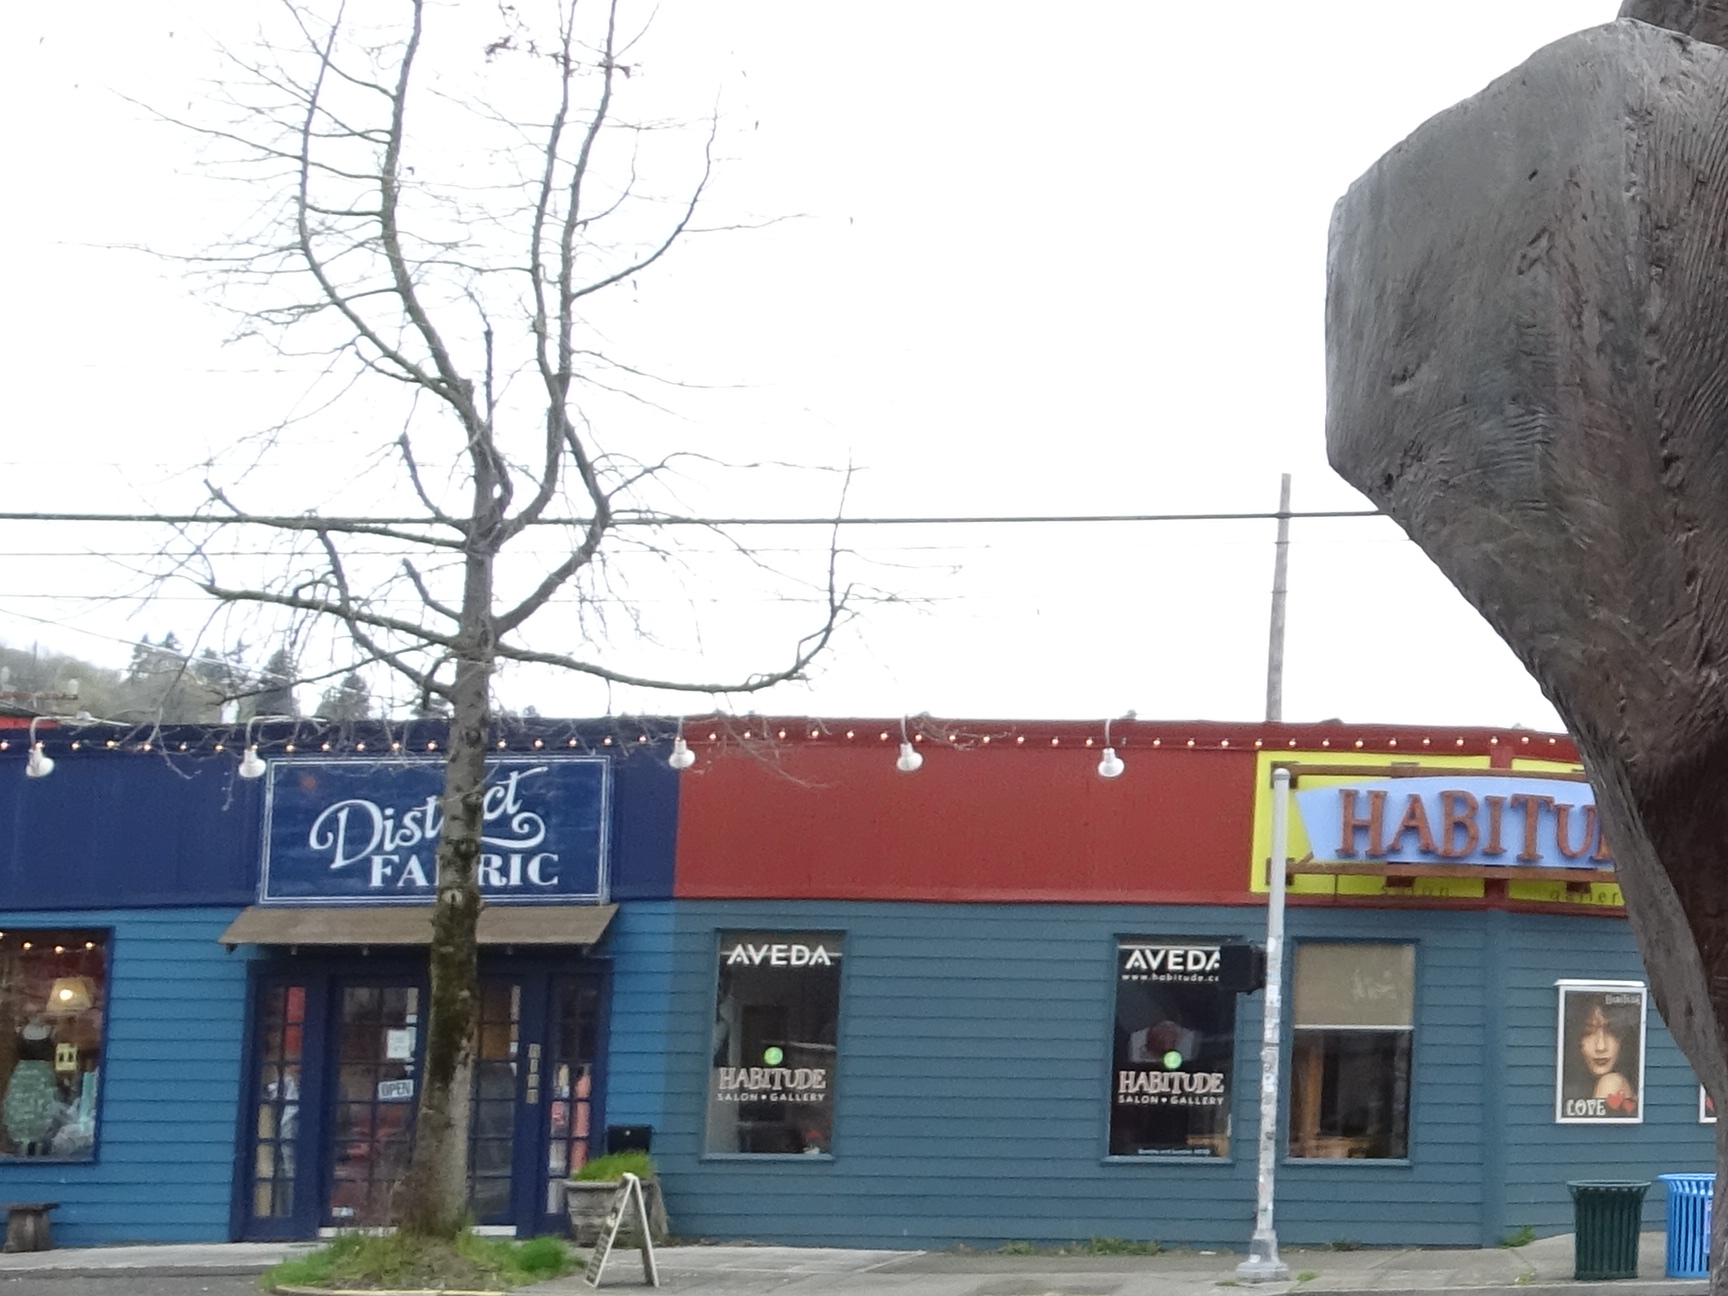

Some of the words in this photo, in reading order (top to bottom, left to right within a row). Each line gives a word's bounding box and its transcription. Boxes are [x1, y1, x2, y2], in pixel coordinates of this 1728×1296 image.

[309, 765, 549, 870] Distct
[369, 853, 560, 888] FARIC
[726, 943, 832, 966] AVEDA
[1124, 949, 1221, 971] AVEDA
[381, 1080, 412, 1098] OPEN
[718, 1067, 827, 1090] HABITUDE
[1118, 1071, 1225, 1094] HABITUDE
[717, 1092, 758, 1102] SALON
[769, 1092, 826, 1102] GALLERY
[1118, 1095, 1159, 1105] SALON
[1169, 1095, 1225, 1106] GALLERY
[1565, 1098, 1607, 1117] LOVE
